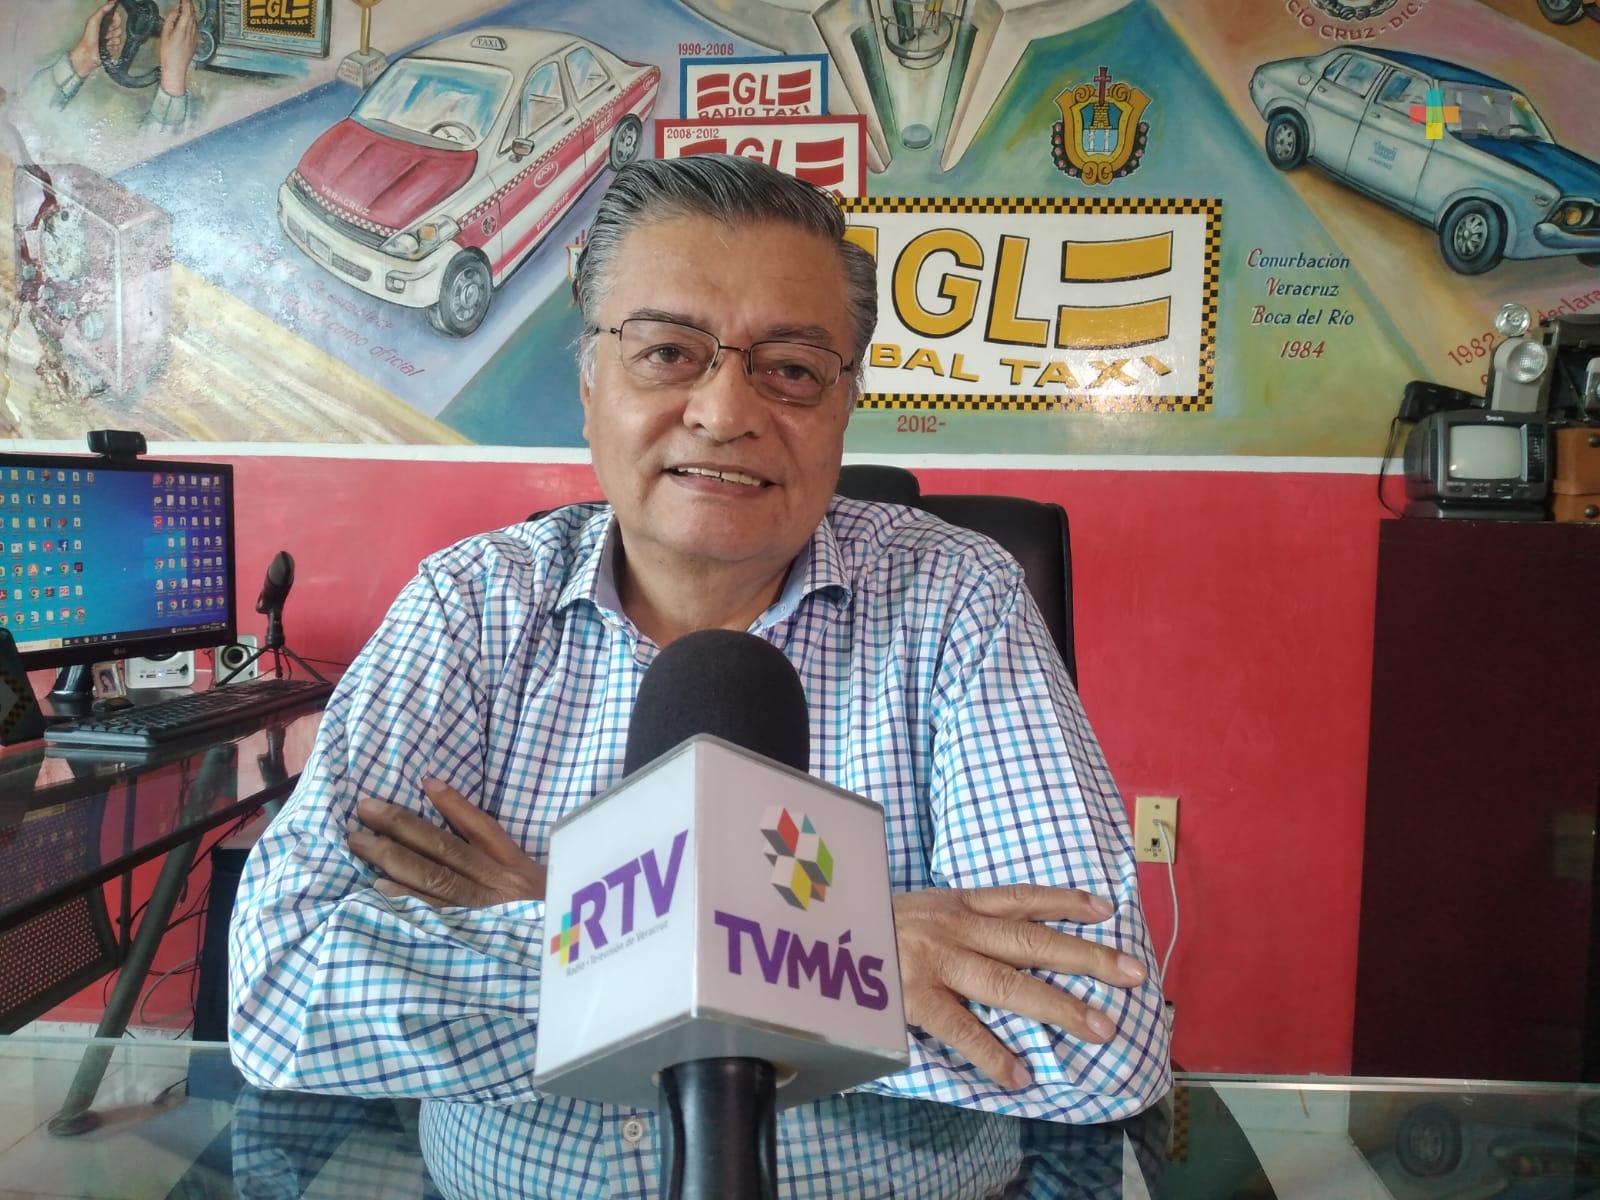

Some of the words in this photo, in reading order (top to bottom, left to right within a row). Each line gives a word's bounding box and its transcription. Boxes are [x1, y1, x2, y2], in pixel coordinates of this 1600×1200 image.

[1321, 24, 1375, 40] CRUZ
[477, 38, 498, 48] TAXI
[678, 43, 734, 56] 1990-2008
[698, 107, 756, 119] RADIO
[763, 104, 810, 117] TAXI
[666, 128, 720, 140] 2008-2012
[321, 183, 370, 217] VERACRUZ
[1266, 277, 1340, 297] Veracruz
[1252, 305, 1291, 325] Boca
[1296, 308, 1323, 325] del
[1328, 308, 1354, 326] Río
[328, 322, 368, 346] como
[369, 346, 425, 376] oficial
[1280, 340, 1326, 358] 1984
[1000, 355, 1172, 389] TAXI
[897, 415, 946, 433] 2012-
[568, 829, 688, 963] RTV
[714, 909, 888, 1011] TVMÁS
